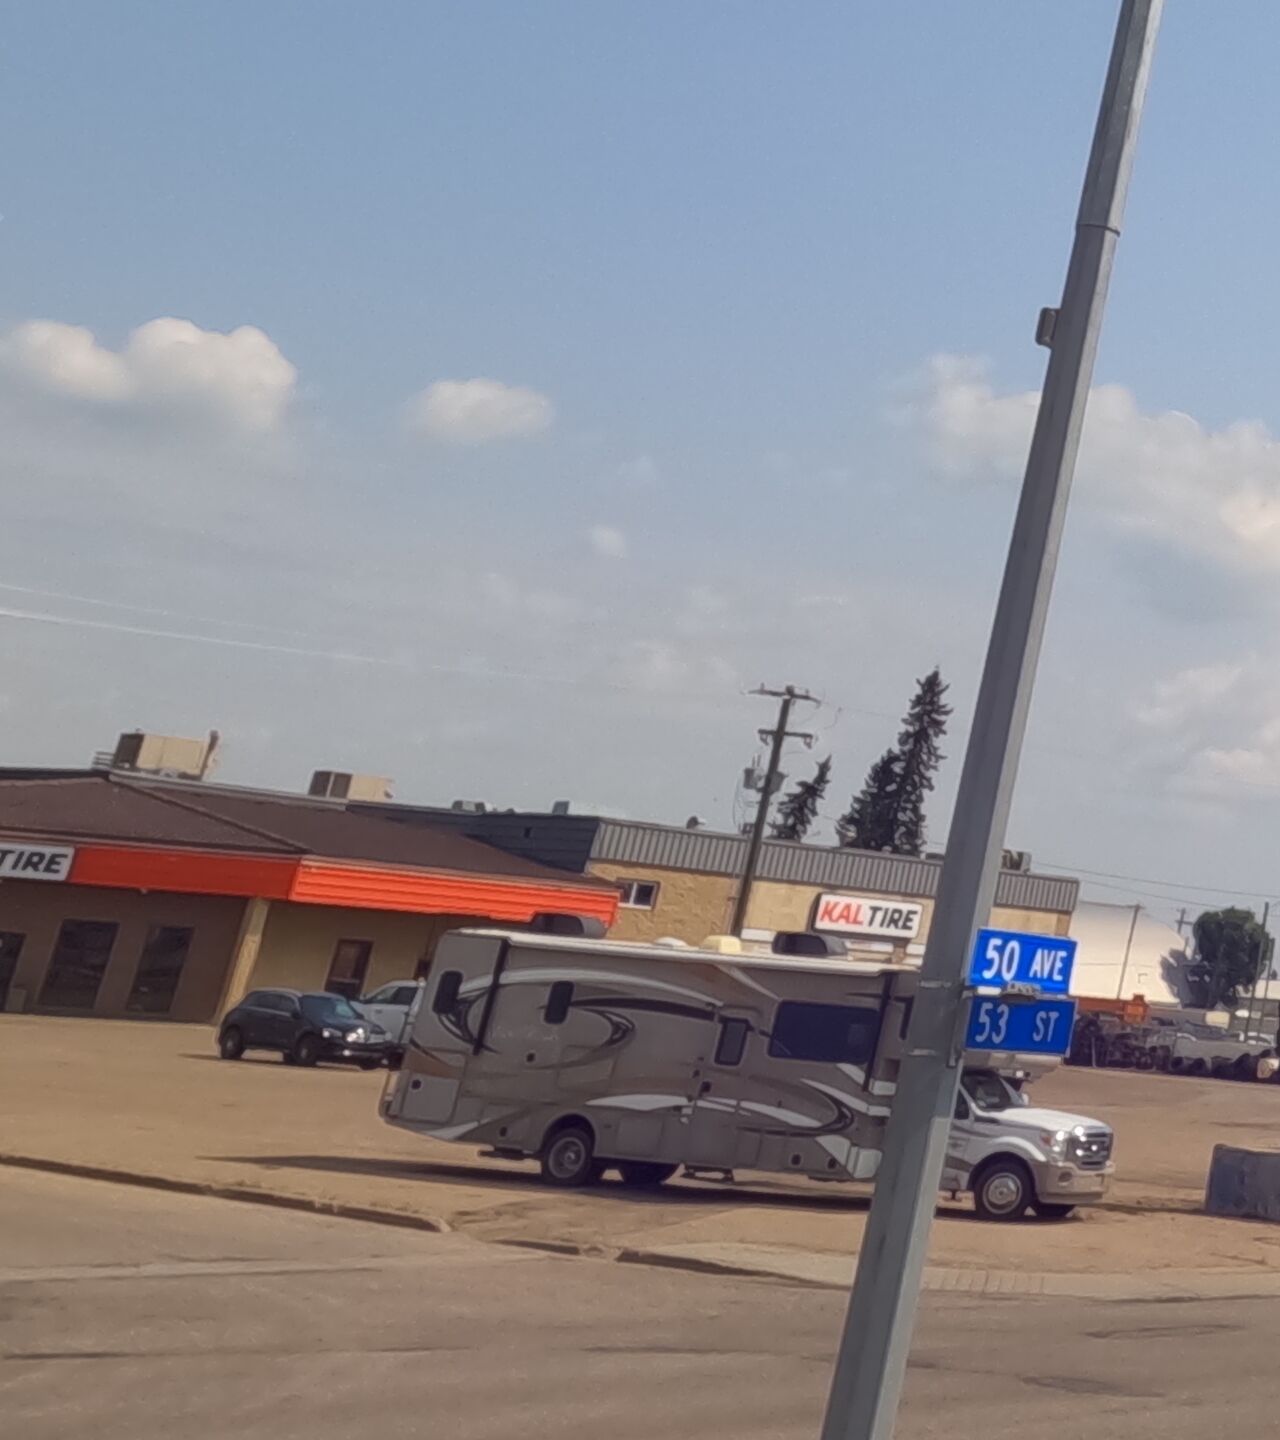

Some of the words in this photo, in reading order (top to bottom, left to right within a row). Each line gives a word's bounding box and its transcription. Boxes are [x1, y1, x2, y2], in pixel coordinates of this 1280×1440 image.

[0, 849, 68, 874] TIRE
[982, 937, 1021, 981] 50
[1028, 947, 1068, 981] AVE
[974, 1002, 1010, 1044] 53
[1032, 1011, 1060, 1042] ST
